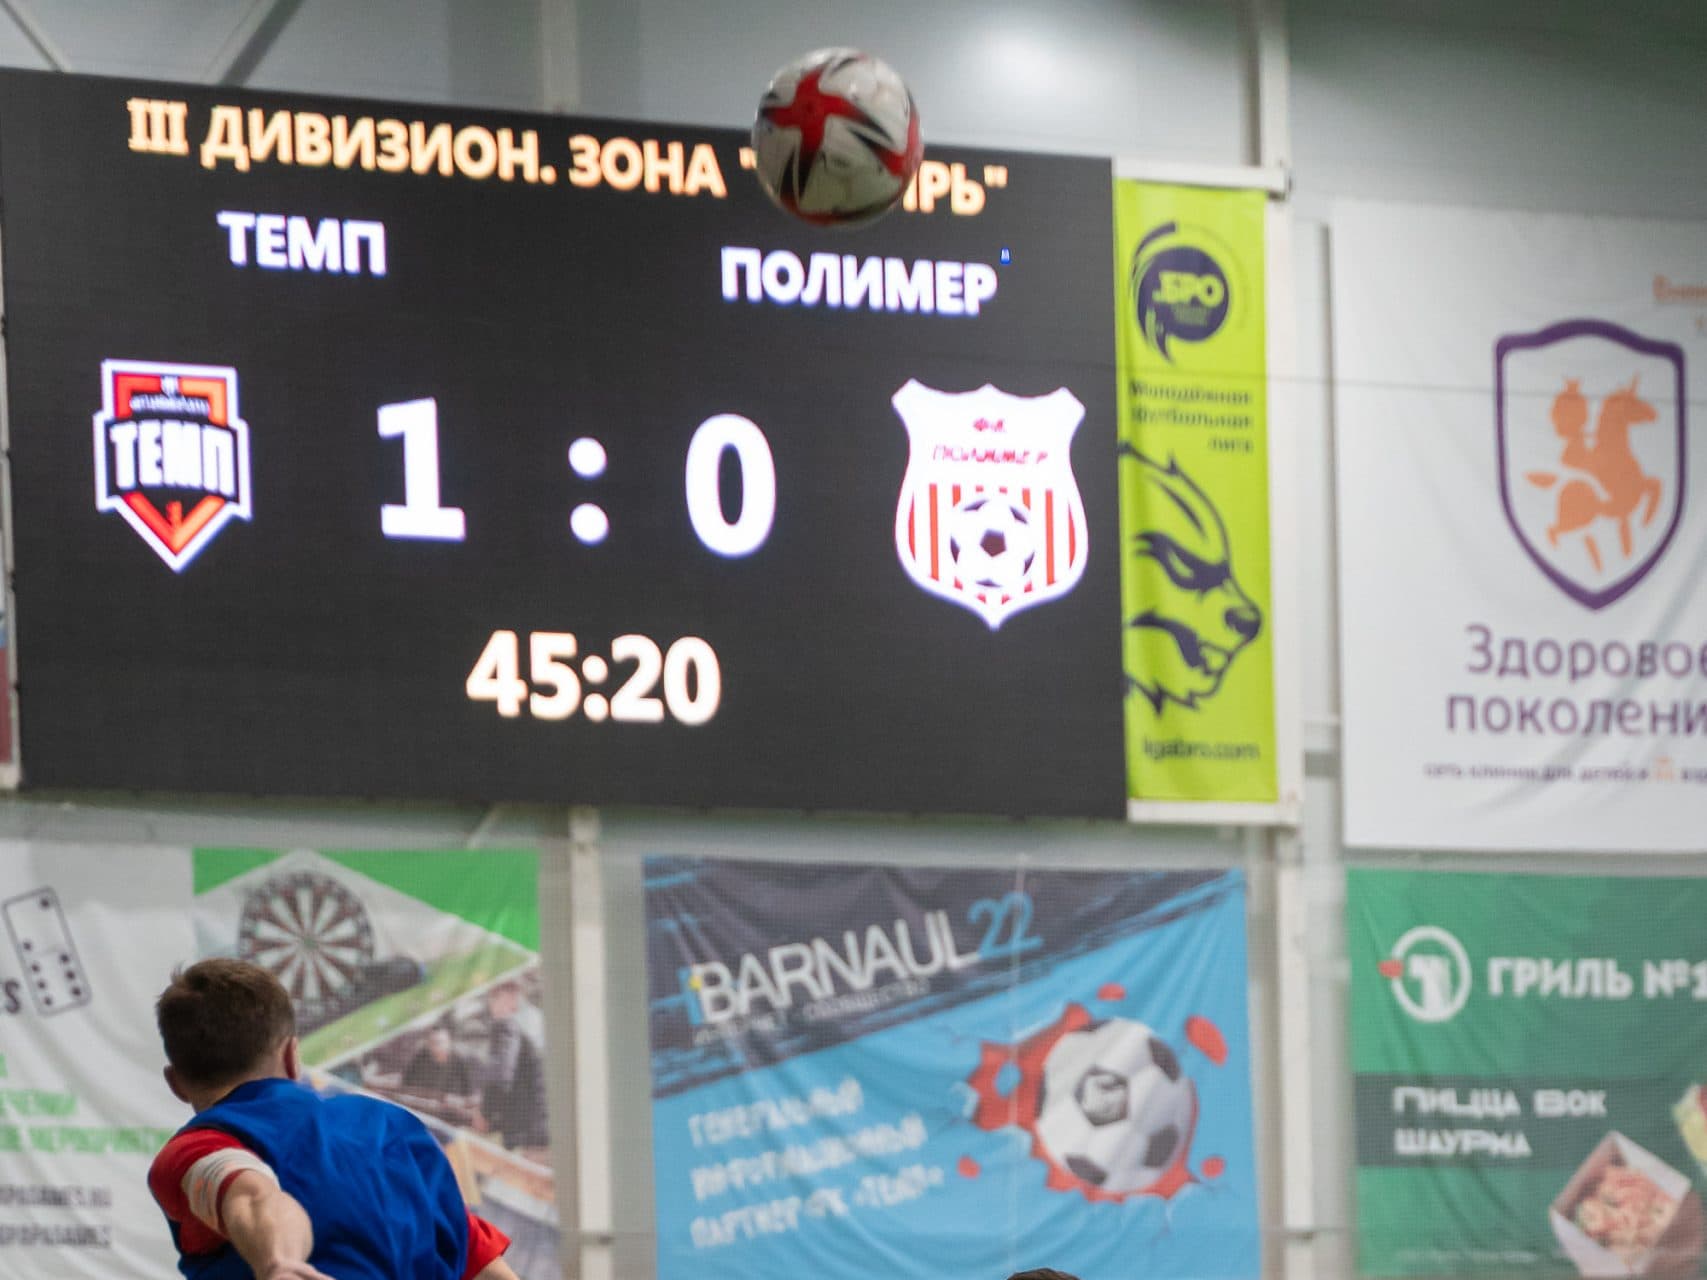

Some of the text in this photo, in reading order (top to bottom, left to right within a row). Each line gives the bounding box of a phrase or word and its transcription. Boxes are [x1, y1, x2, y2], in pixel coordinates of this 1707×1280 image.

[200, 106, 556, 184] ДИВИЗИОН.
[568, 135, 727, 198] ЗОНА
[217, 210, 387, 276] ТЕМП
[721, 246, 997, 316] ПОЛИМЕР
[109, 420, 237, 495] ТЕМП
[377, 397, 466, 542] 1
[685, 413, 776, 558] 0
[465, 629, 721, 726] 45:20
[1488, 956, 1634, 998] ГРИЛЬ
